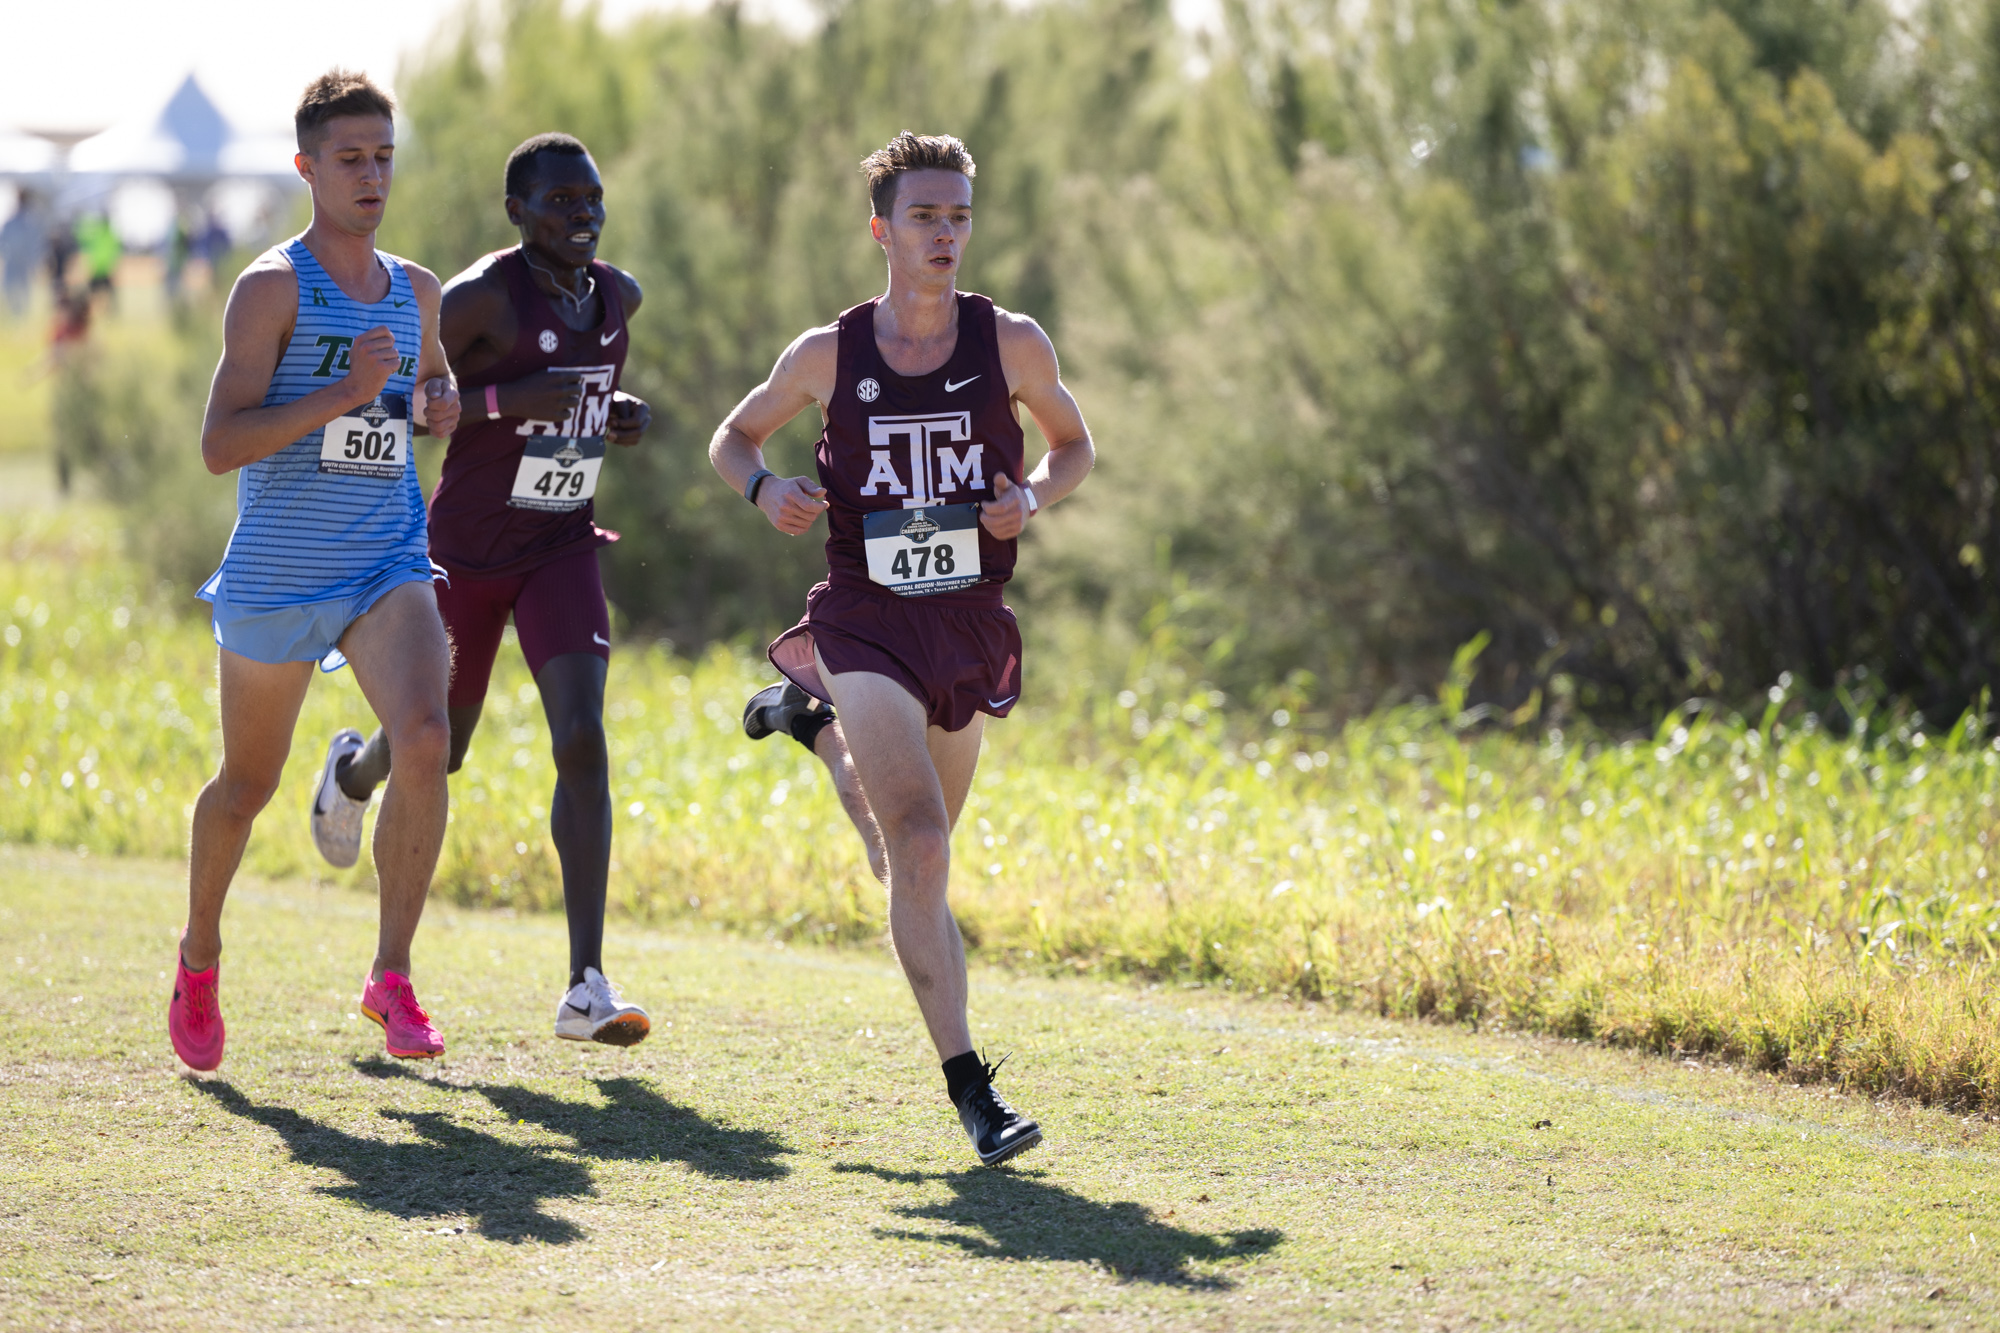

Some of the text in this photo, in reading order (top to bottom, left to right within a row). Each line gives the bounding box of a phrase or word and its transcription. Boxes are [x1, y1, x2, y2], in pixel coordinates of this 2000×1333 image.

[311, 335, 416, 377] TUNE
[858, 379, 878, 401] SEC
[344, 430, 396, 461] 502
[534, 470, 585, 497] 479
[891, 544, 955, 579] 478
[890, 584, 914, 592] CENTRAL
